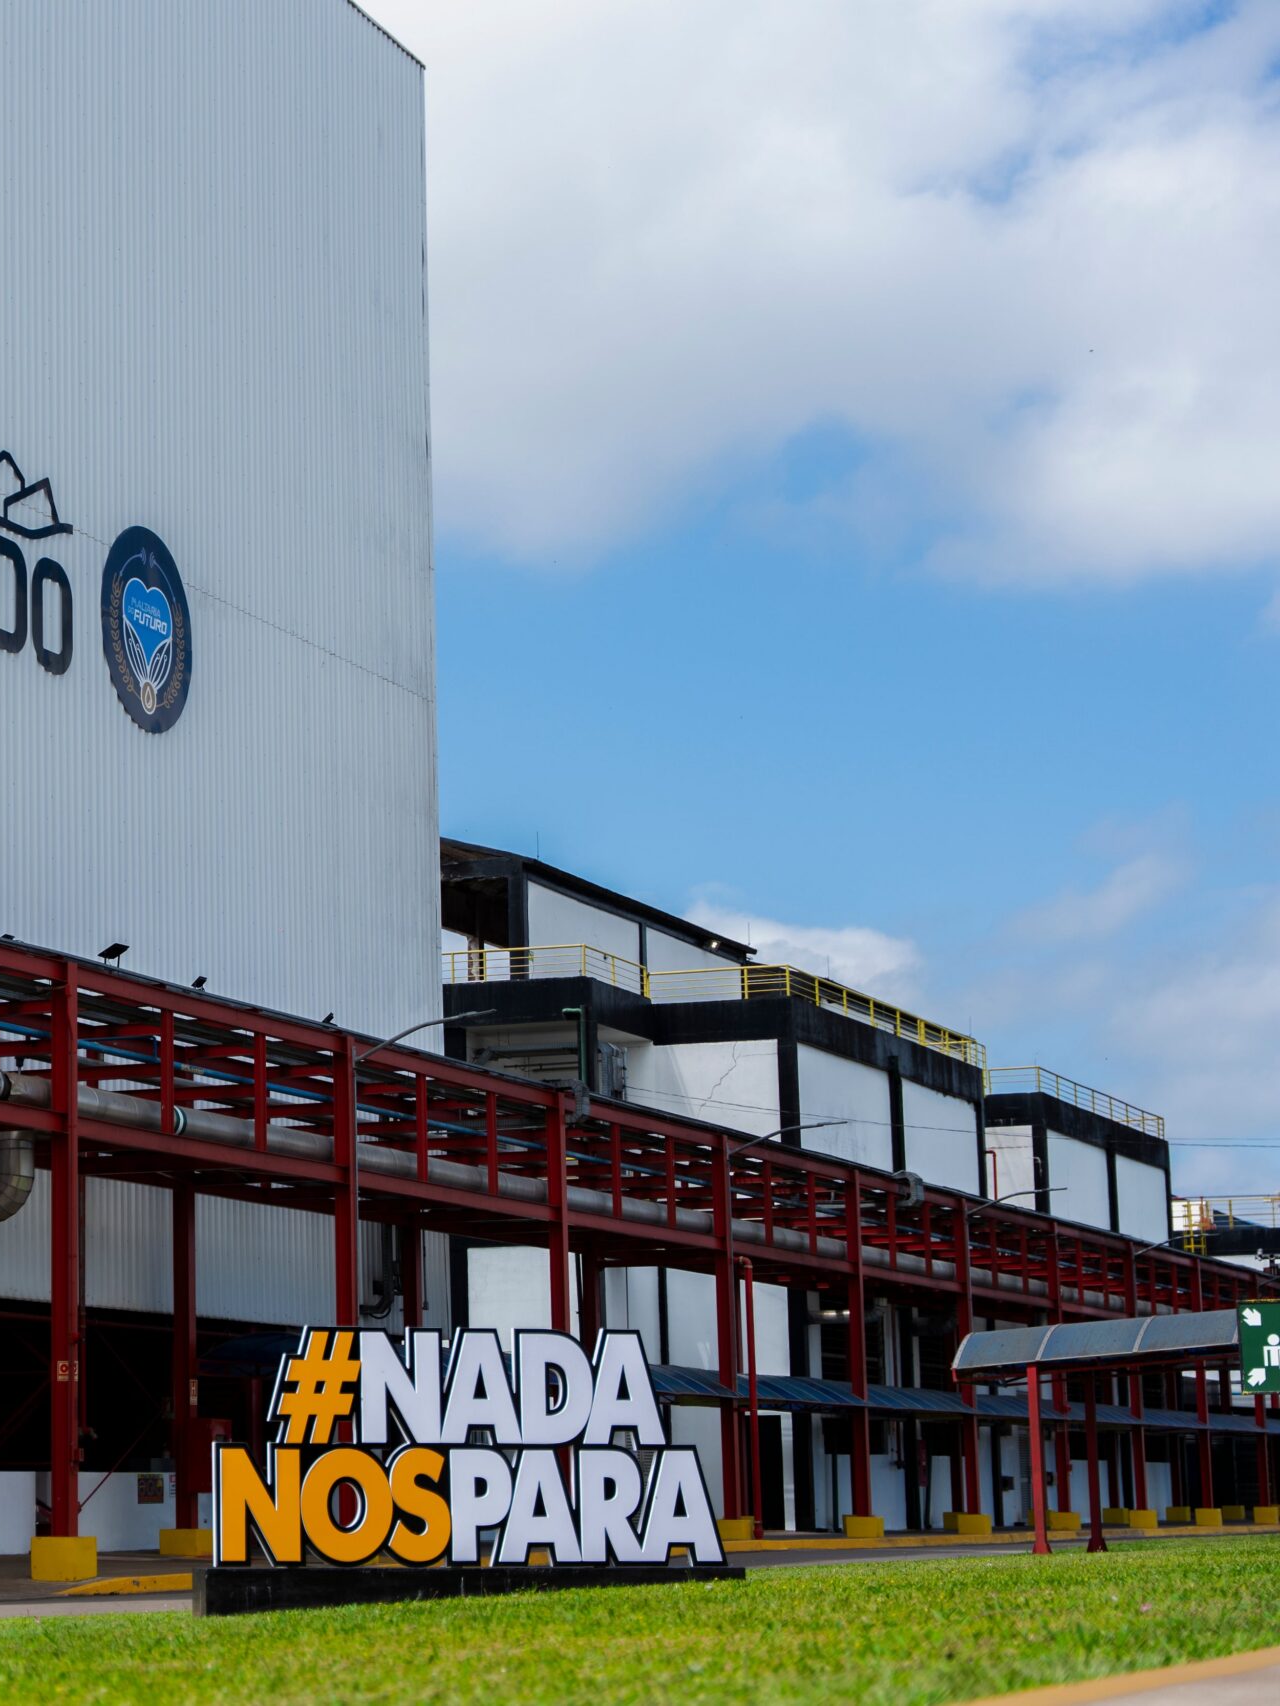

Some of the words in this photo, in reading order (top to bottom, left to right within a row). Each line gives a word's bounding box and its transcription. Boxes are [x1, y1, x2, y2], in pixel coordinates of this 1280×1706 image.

[131, 597, 161, 618] MALTARIA
[133, 608, 168, 635] FUTURO
[274, 1329, 668, 1446] #NADA
